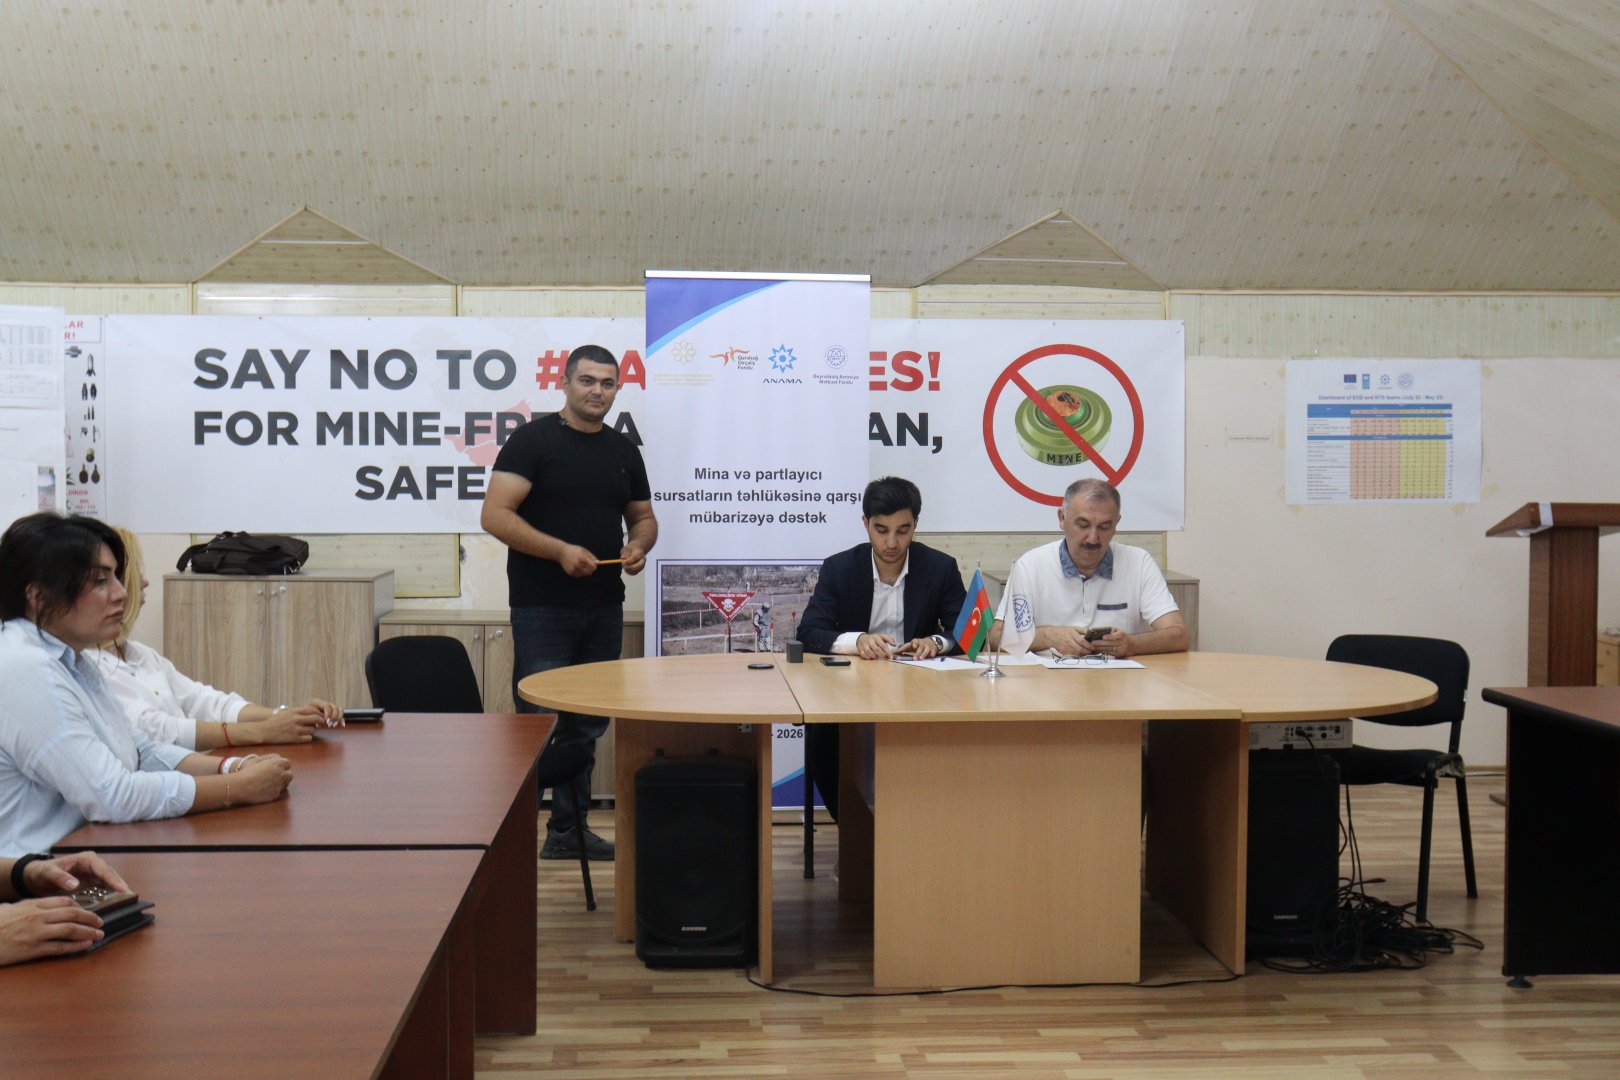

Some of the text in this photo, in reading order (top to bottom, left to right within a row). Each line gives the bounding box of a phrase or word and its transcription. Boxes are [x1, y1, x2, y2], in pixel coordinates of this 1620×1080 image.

[194, 349, 310, 390] SAY
[330, 349, 417, 390] NO
[437, 349, 517, 390] TO
[195, 411, 298, 446] FOR
[1047, 452, 1082, 464] MINE
[355, 466, 486, 500] SAFE
[694, 467, 822, 483] Mina və partlayıcı
[654, 489, 862, 505] sursatların təhlükəsinə qarşı
[689, 511, 827, 526] mübarizəyə dəstək
[777, 729, 803, 738] 2026
